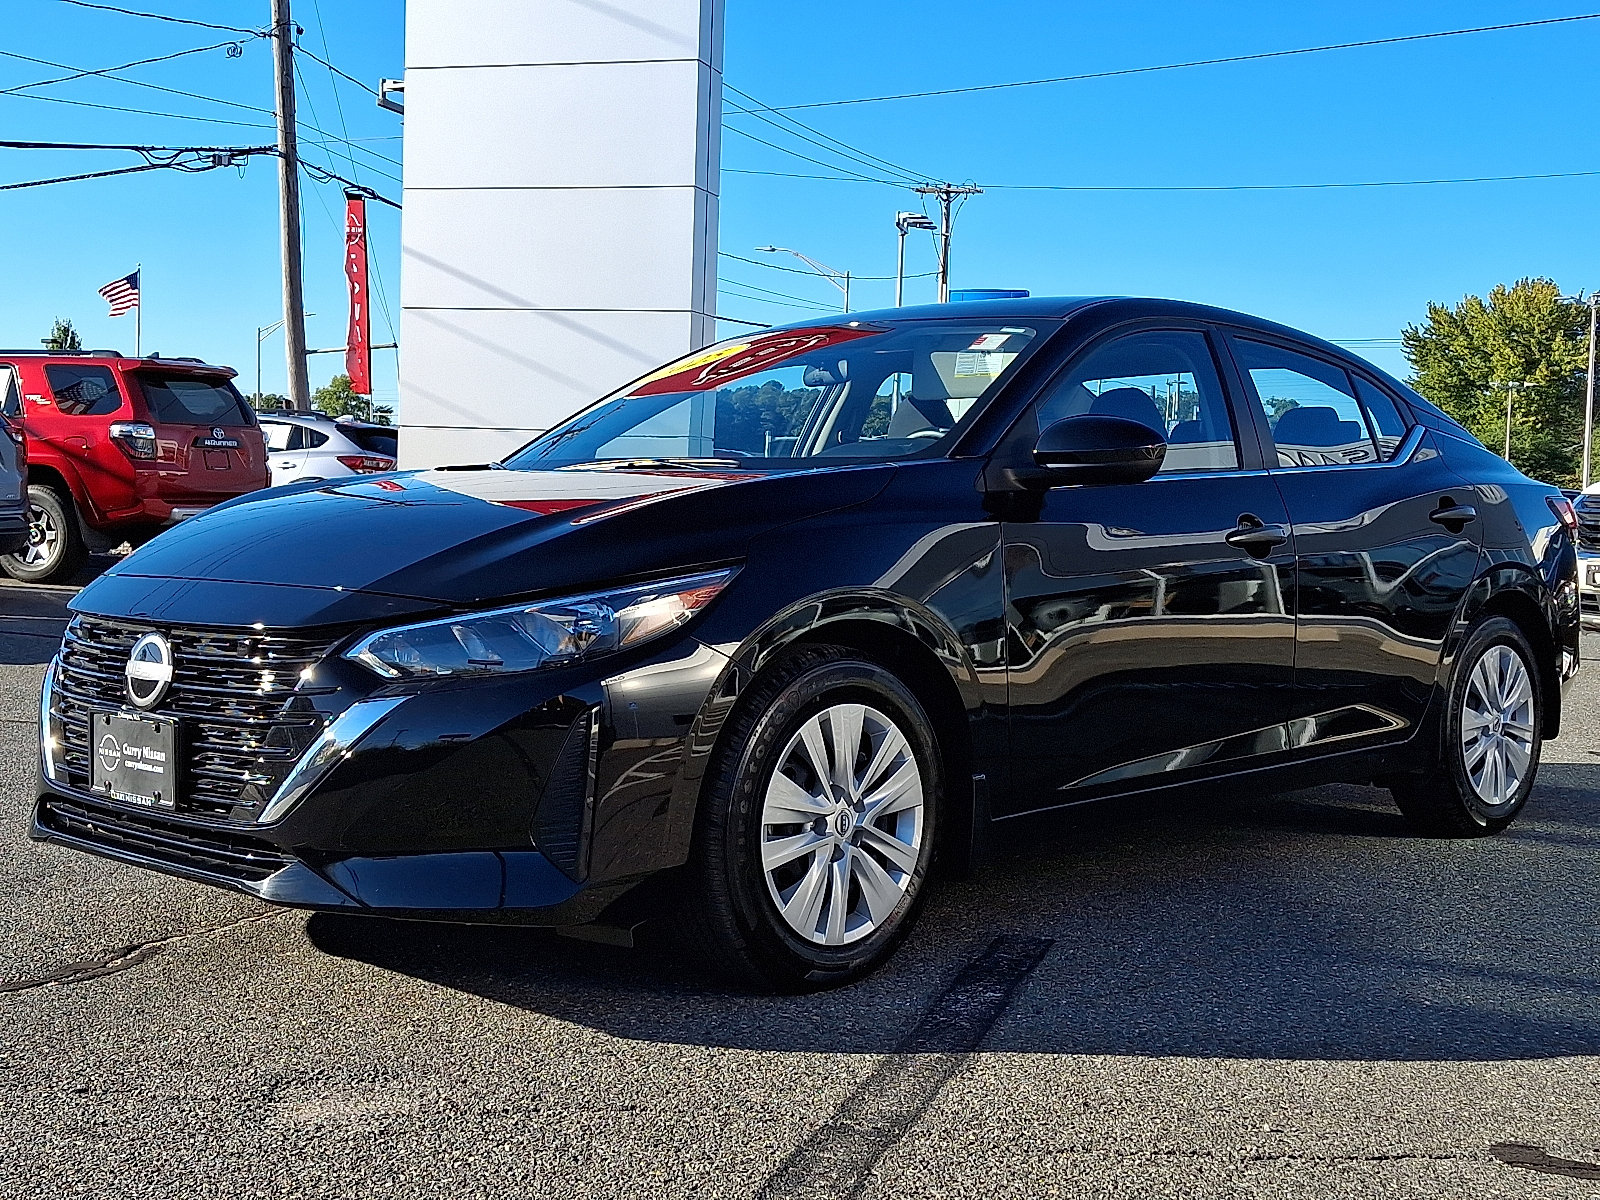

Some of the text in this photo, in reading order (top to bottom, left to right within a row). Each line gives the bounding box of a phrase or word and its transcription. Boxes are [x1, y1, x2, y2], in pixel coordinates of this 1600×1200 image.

[98, 747, 121, 758] NISSAN
[122, 742, 166, 762] Curry Nissan
